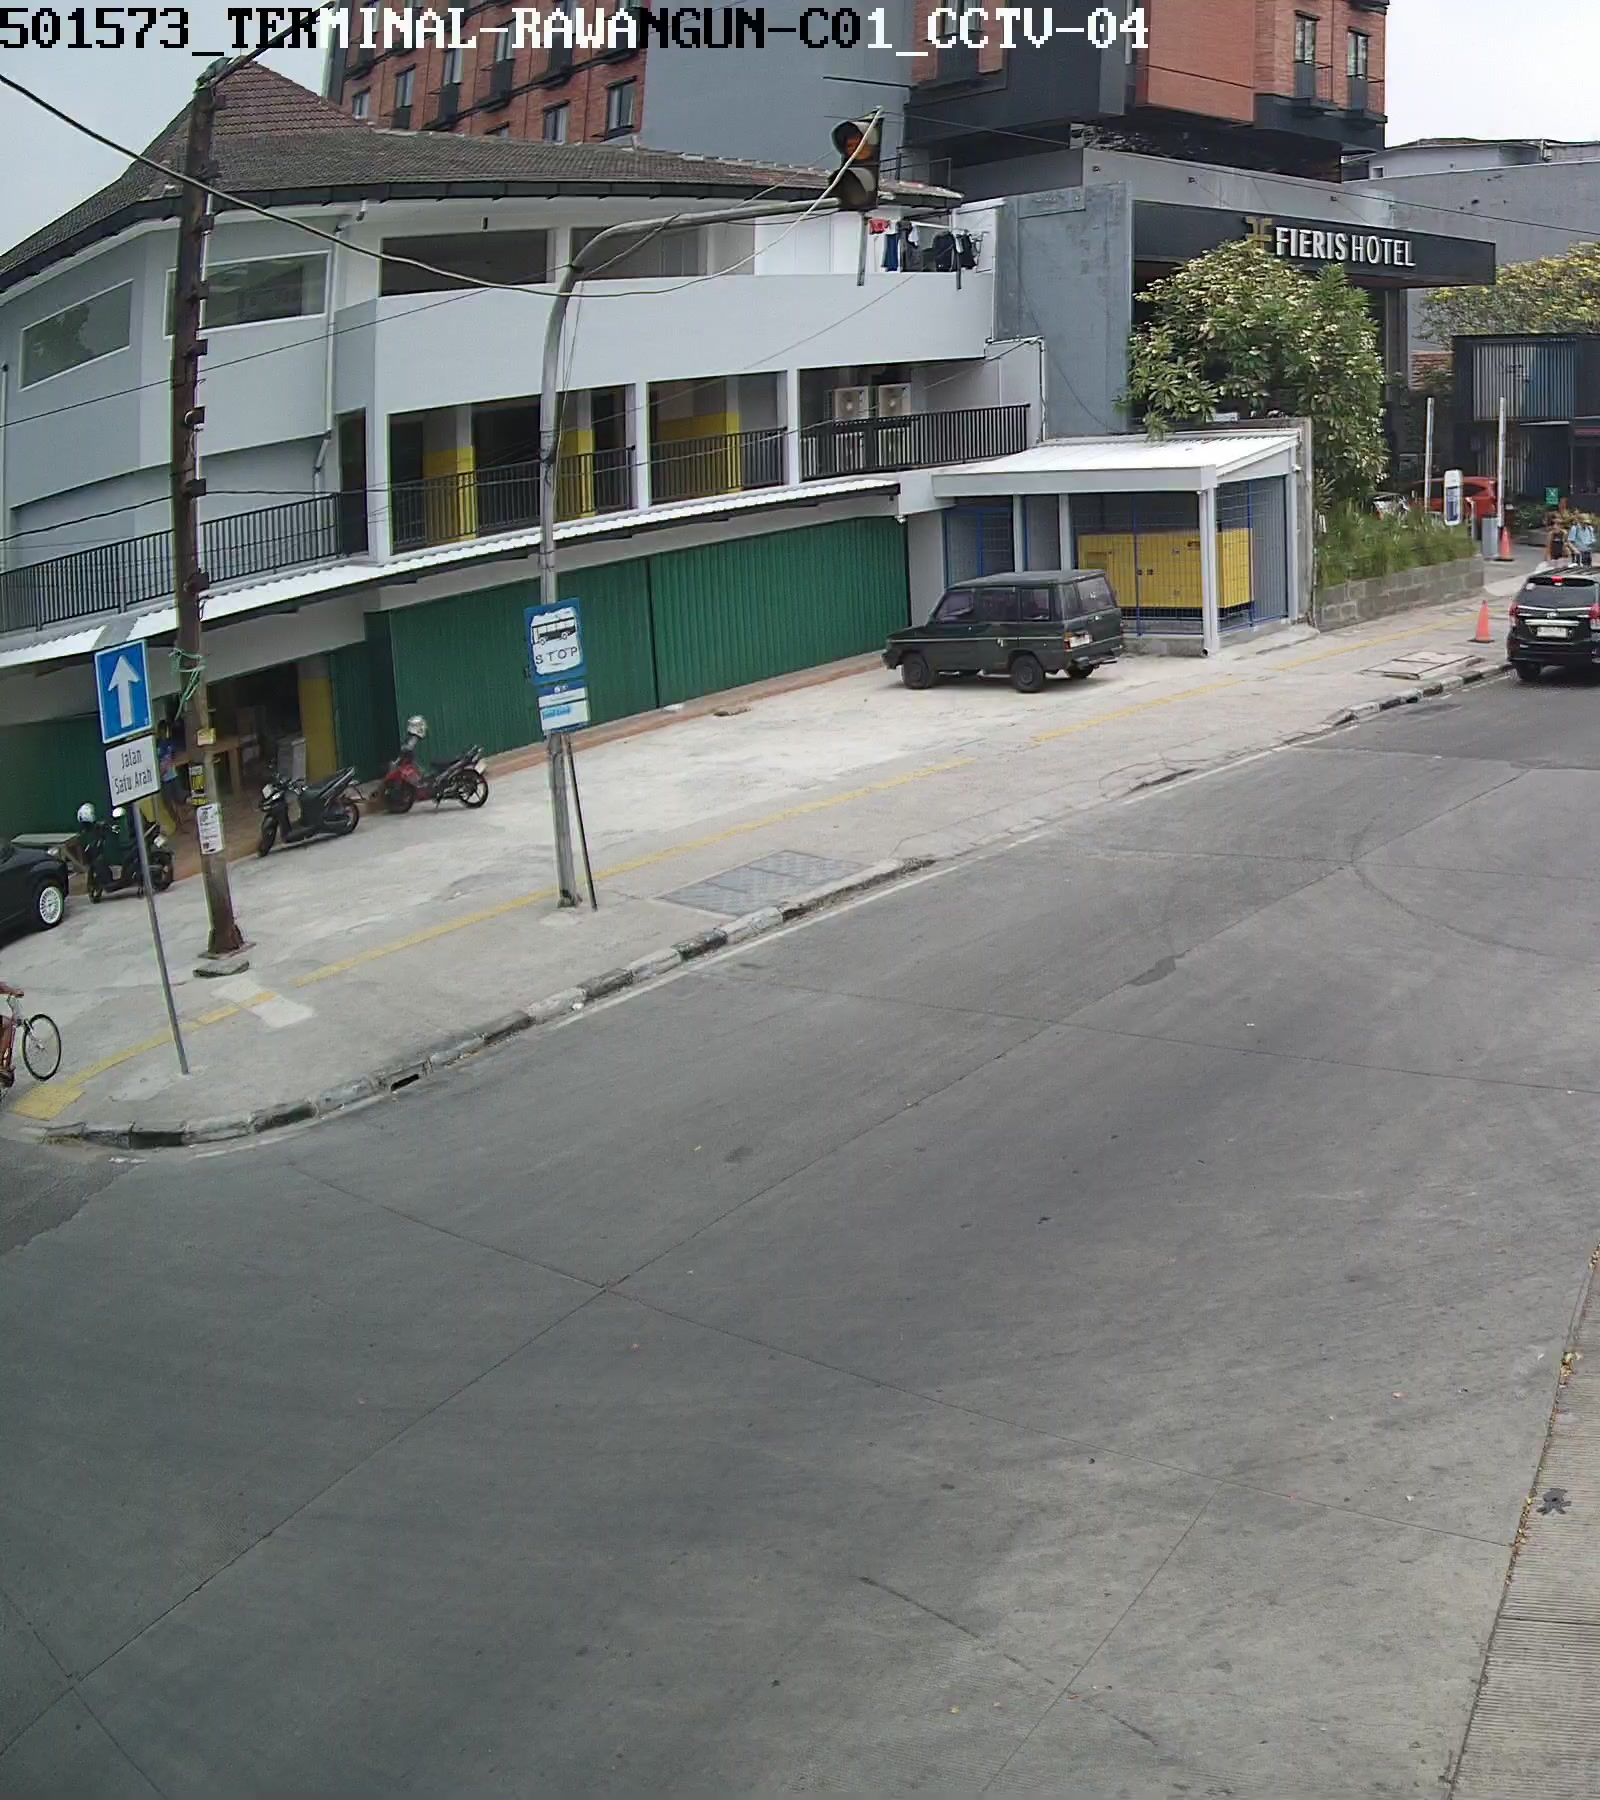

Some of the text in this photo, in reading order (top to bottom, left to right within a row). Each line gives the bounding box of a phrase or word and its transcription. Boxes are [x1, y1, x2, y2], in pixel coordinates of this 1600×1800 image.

[1276, 226, 1417, 267] FIERIS HOTEL
[534, 645, 578, 665] STOP
[120, 748, 143, 770] Jalan
[113, 767, 153, 796] Satu Arah
